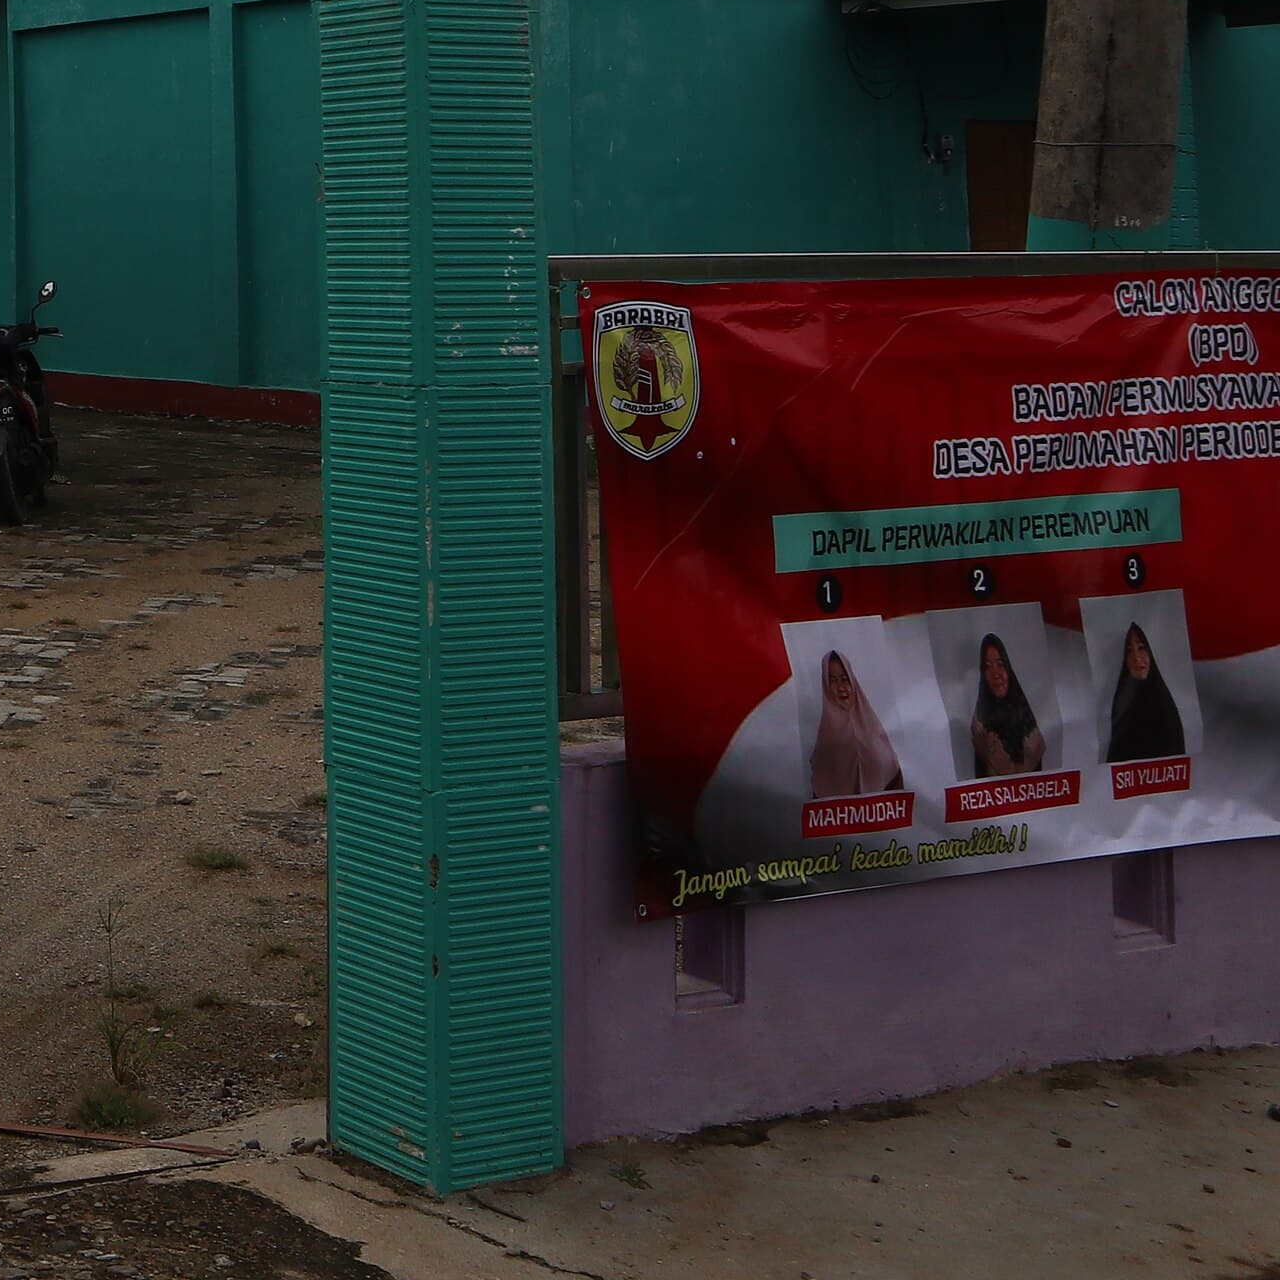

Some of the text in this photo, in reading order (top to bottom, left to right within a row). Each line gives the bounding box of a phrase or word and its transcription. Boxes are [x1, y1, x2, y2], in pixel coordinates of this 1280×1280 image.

[1115, 277, 1199, 317] CALON
[602, 308, 685, 331] BARABAI
[1188, 321, 1260, 368] (BPD)
[1012, 372, 1280, 422] BADAN PERMUSYAWA
[934, 421, 1280, 478] DESA PERUMAHAN PERIODE
[811, 506, 1152, 556] DAPIL PERWAKILAN PEREMPUAN
[972, 569, 987, 592] 2
[1127, 557, 1139, 581] 3
[823, 580, 832, 604] 1
[1115, 762, 1189, 789] SRI YULIATI
[960, 778, 1071, 811] REZA SALSABELA
[808, 799, 907, 829] MAHMUDAH
[671, 866, 751, 908] Jangan
[756, 843, 842, 886] sampai
[850, 838, 913, 872] kada
